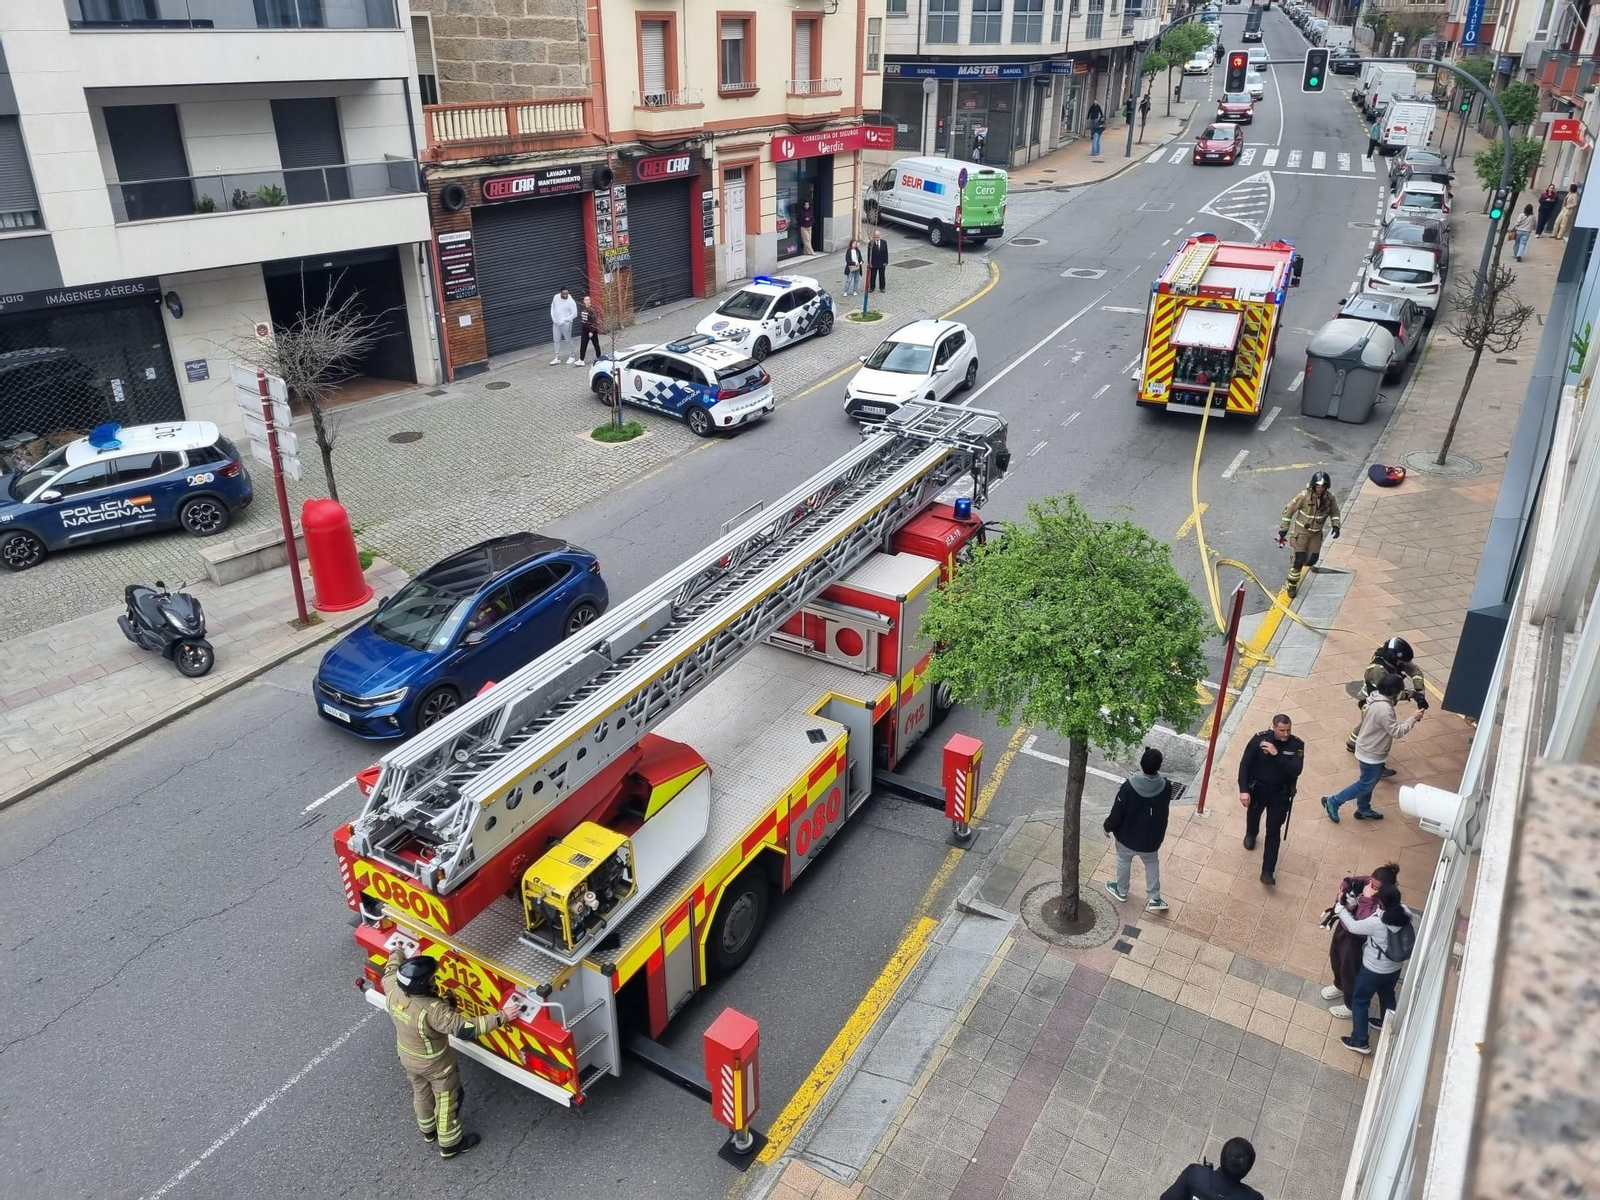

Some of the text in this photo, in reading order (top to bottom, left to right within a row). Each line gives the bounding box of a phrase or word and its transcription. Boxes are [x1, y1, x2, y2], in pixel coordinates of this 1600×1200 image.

[958, 65, 999, 75] MASTER
[538, 175, 580, 186] MANTENIMIENTO
[902, 174, 922, 190] SEUR
[975, 186, 996, 195] Cero
[45, 290, 102, 305] IMÁGENES
[104, 283, 145, 297] AÉREAS
[63, 505, 155, 528] NACIONAL
[796, 788, 841, 855] 080
[371, 871, 430, 919] 080
[448, 962, 484, 994] 112
